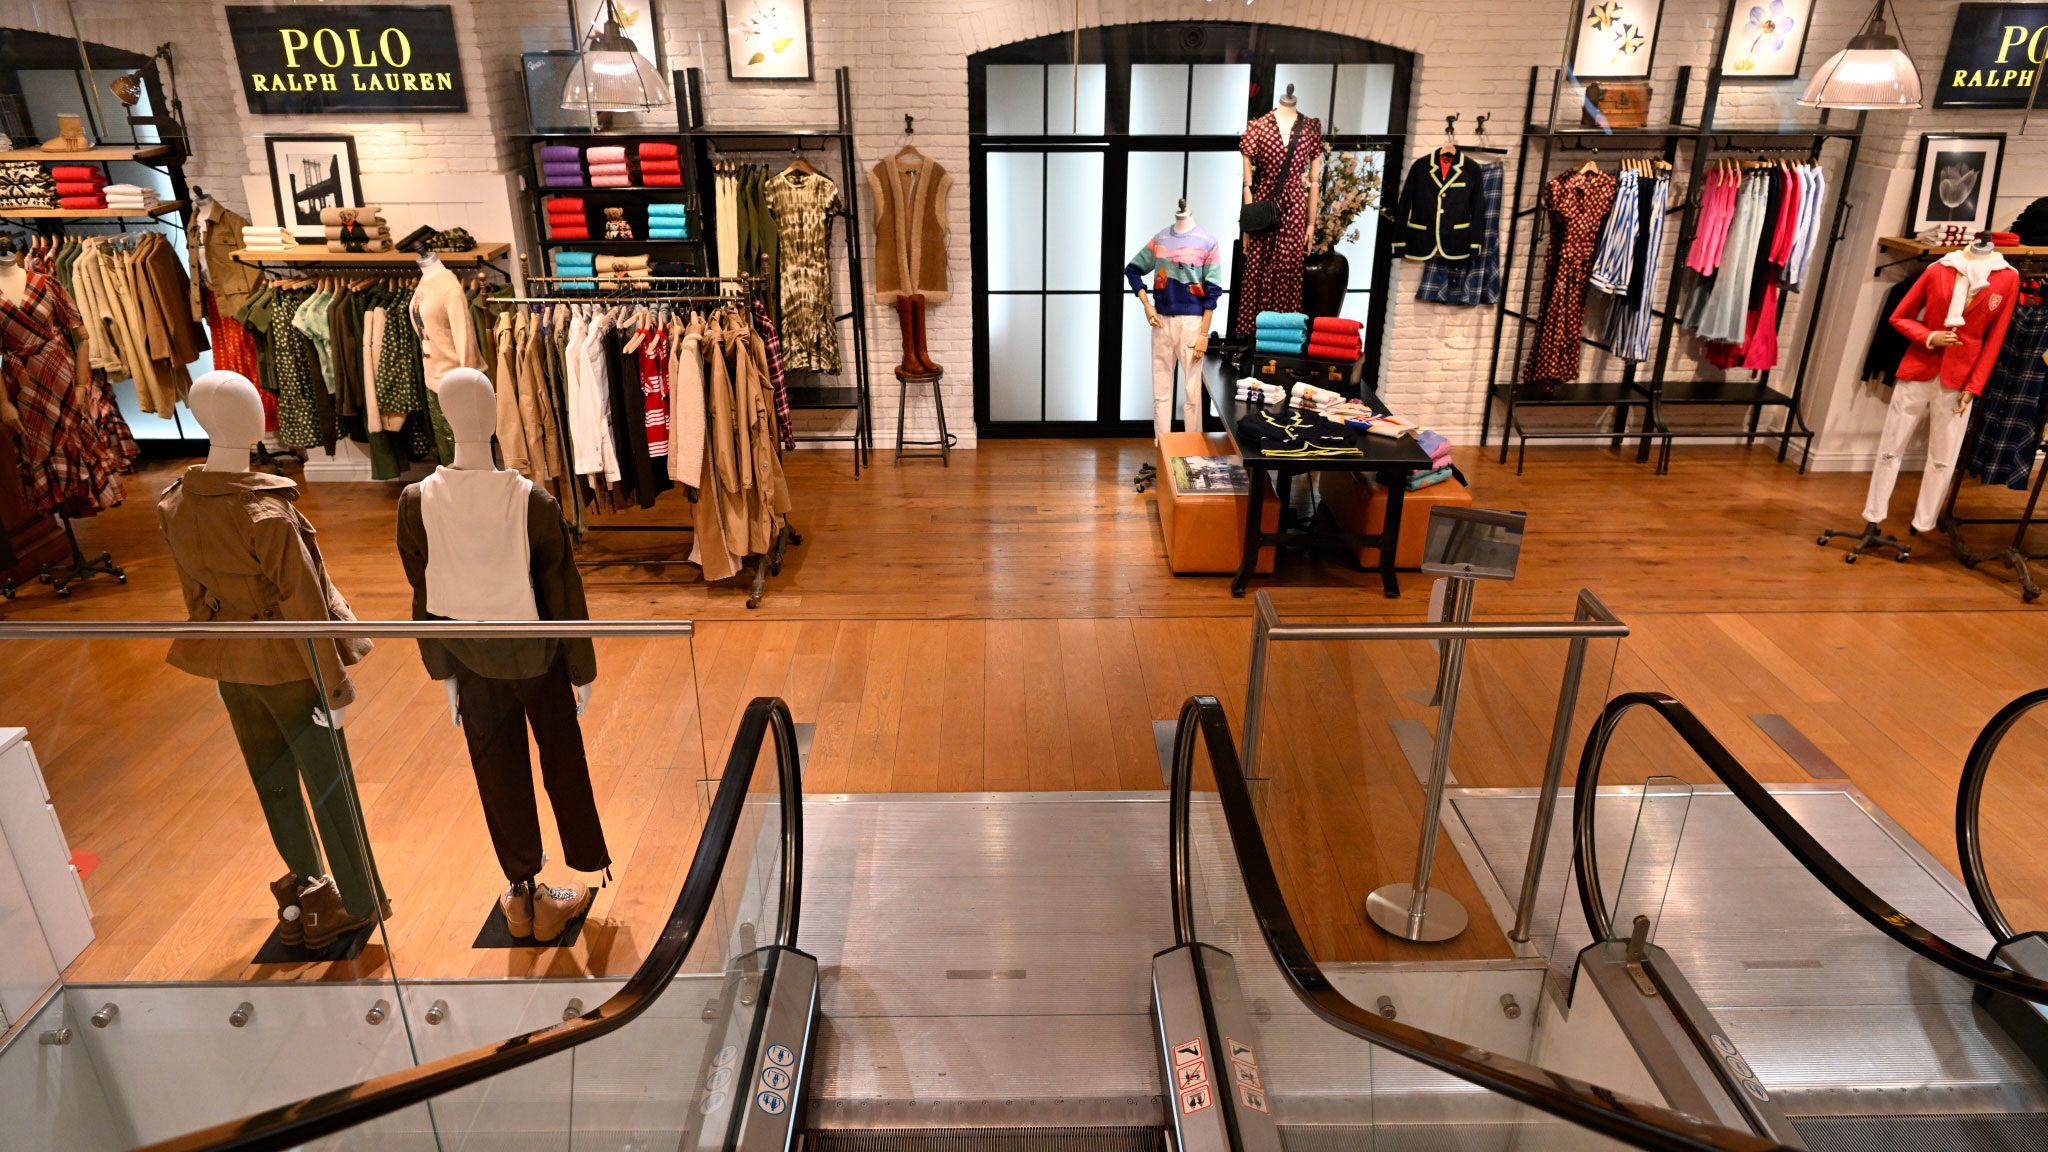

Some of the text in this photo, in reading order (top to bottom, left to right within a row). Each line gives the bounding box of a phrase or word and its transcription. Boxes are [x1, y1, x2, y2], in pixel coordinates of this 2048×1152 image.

[279, 27, 411, 68] POLO
[252, 72, 453, 92] RALPH LAUREN
[1952, 69, 2035, 87] RALPH
